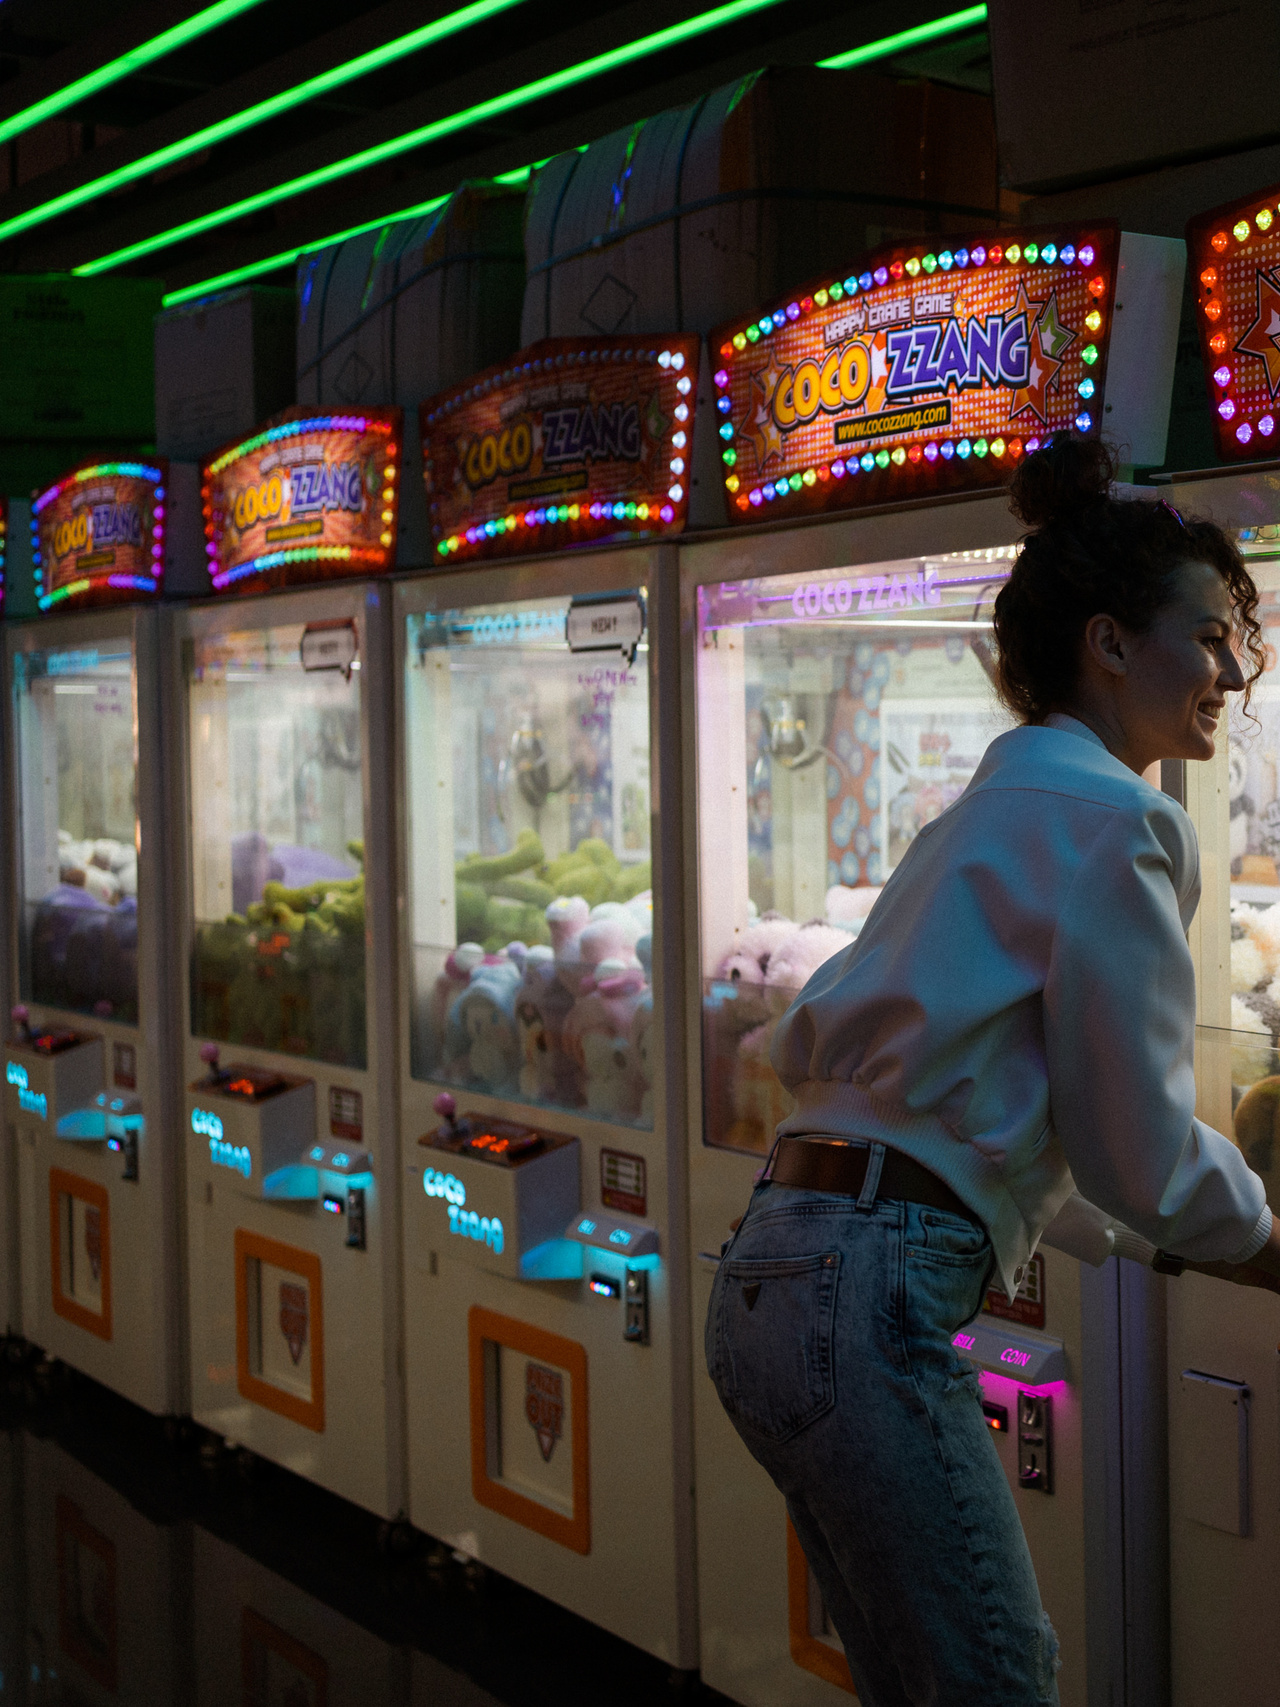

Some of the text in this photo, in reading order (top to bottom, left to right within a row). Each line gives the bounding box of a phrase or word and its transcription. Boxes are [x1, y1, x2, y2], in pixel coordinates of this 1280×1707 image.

[823, 293, 955, 346] HAPPY CRANE GAME
[771, 314, 1031, 427] COCO ZZANG
[465, 404, 641, 486] COCO ZZANG
[837, 405, 948, 440] www.cocozzang.com
[235, 461, 363, 529] COCO ZZANG
[54, 504, 142, 557] COCO ZZANG
[792, 569, 941, 616] COCO ZZANG
[952, 1333, 1031, 1367] BILL COIN
[526, 1394, 565, 1437] OUT
